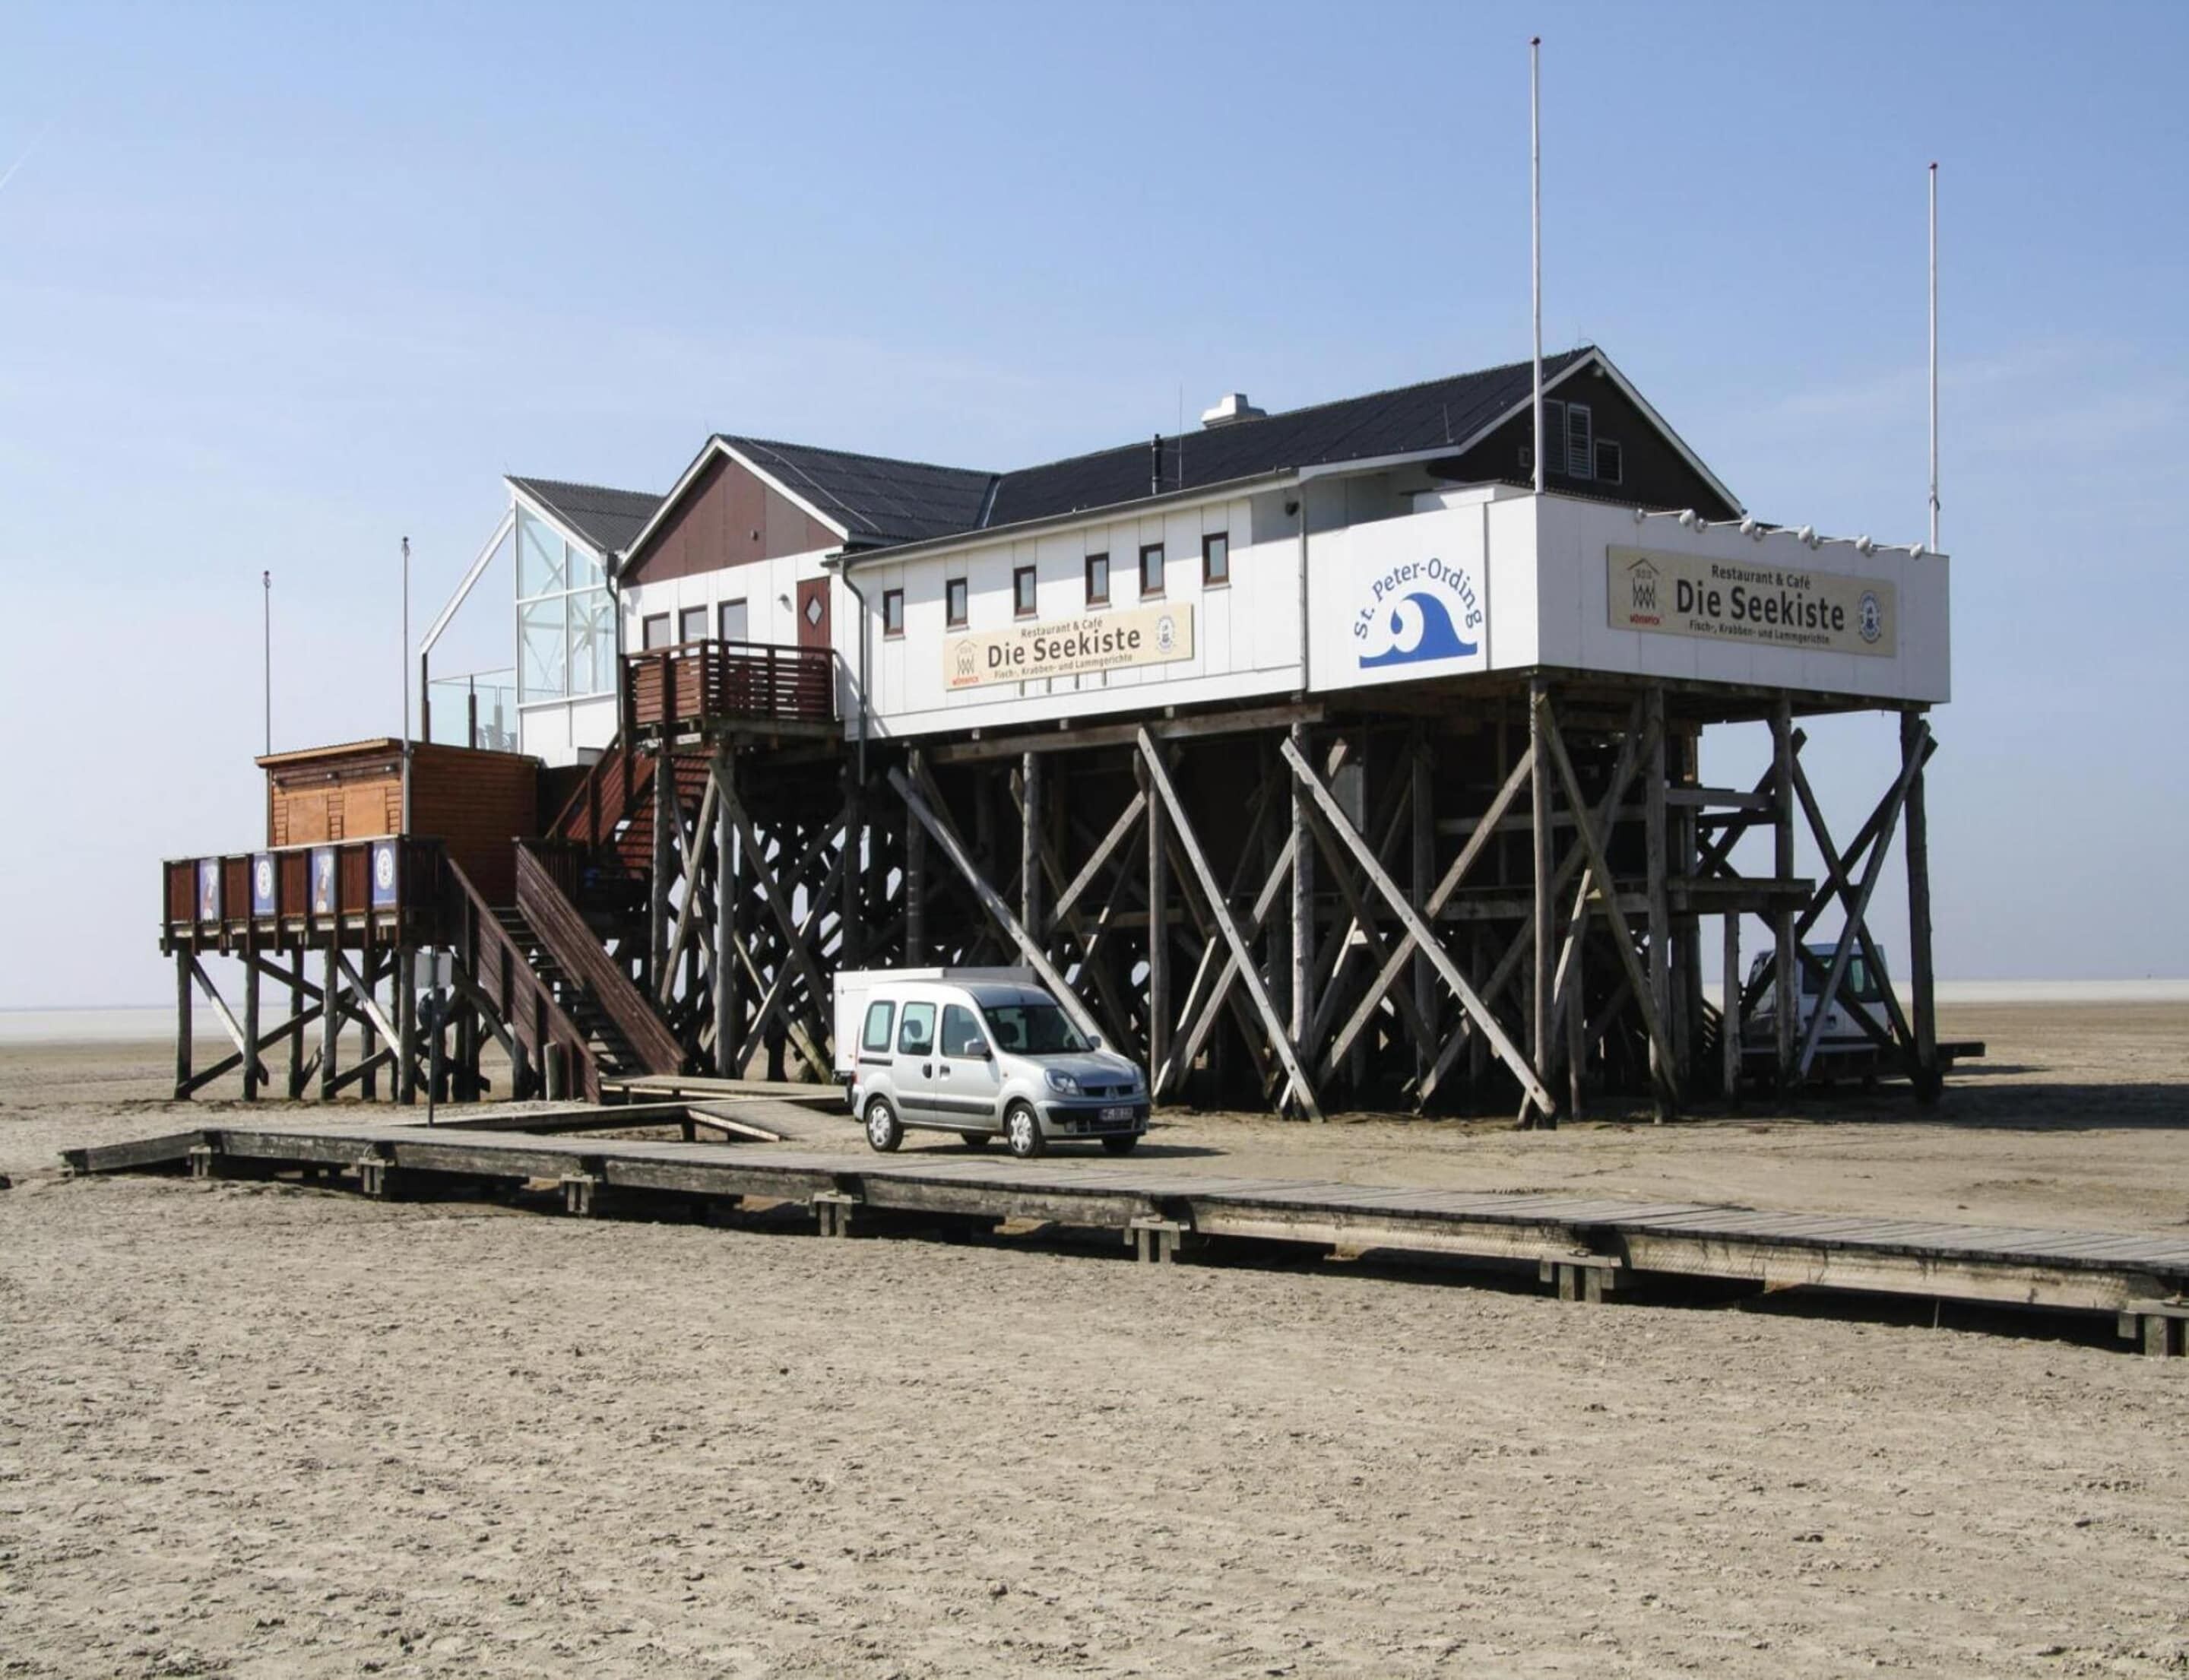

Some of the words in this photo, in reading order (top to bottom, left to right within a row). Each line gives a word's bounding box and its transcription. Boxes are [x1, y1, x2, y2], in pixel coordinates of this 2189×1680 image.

[1712, 564, 1772, 585] Restaurant
[1776, 573, 1783, 586] &
[1787, 574, 1810, 590] Café
[1354, 607, 1375, 639] St.
[1372, 557, 1482, 629] Peter-Ording
[1677, 578, 1722, 618] Die
[1731, 585, 1844, 631] Seekiste
[1021, 623, 1070, 639] Restaurant
[1073, 621, 1079, 631] &
[1082, 616, 1103, 630] Café
[1758, 627, 1772, 639] und
[988, 642, 1025, 668] Die
[1034, 627, 1141, 662] Seekiste
[1059, 660, 1073, 670] und
